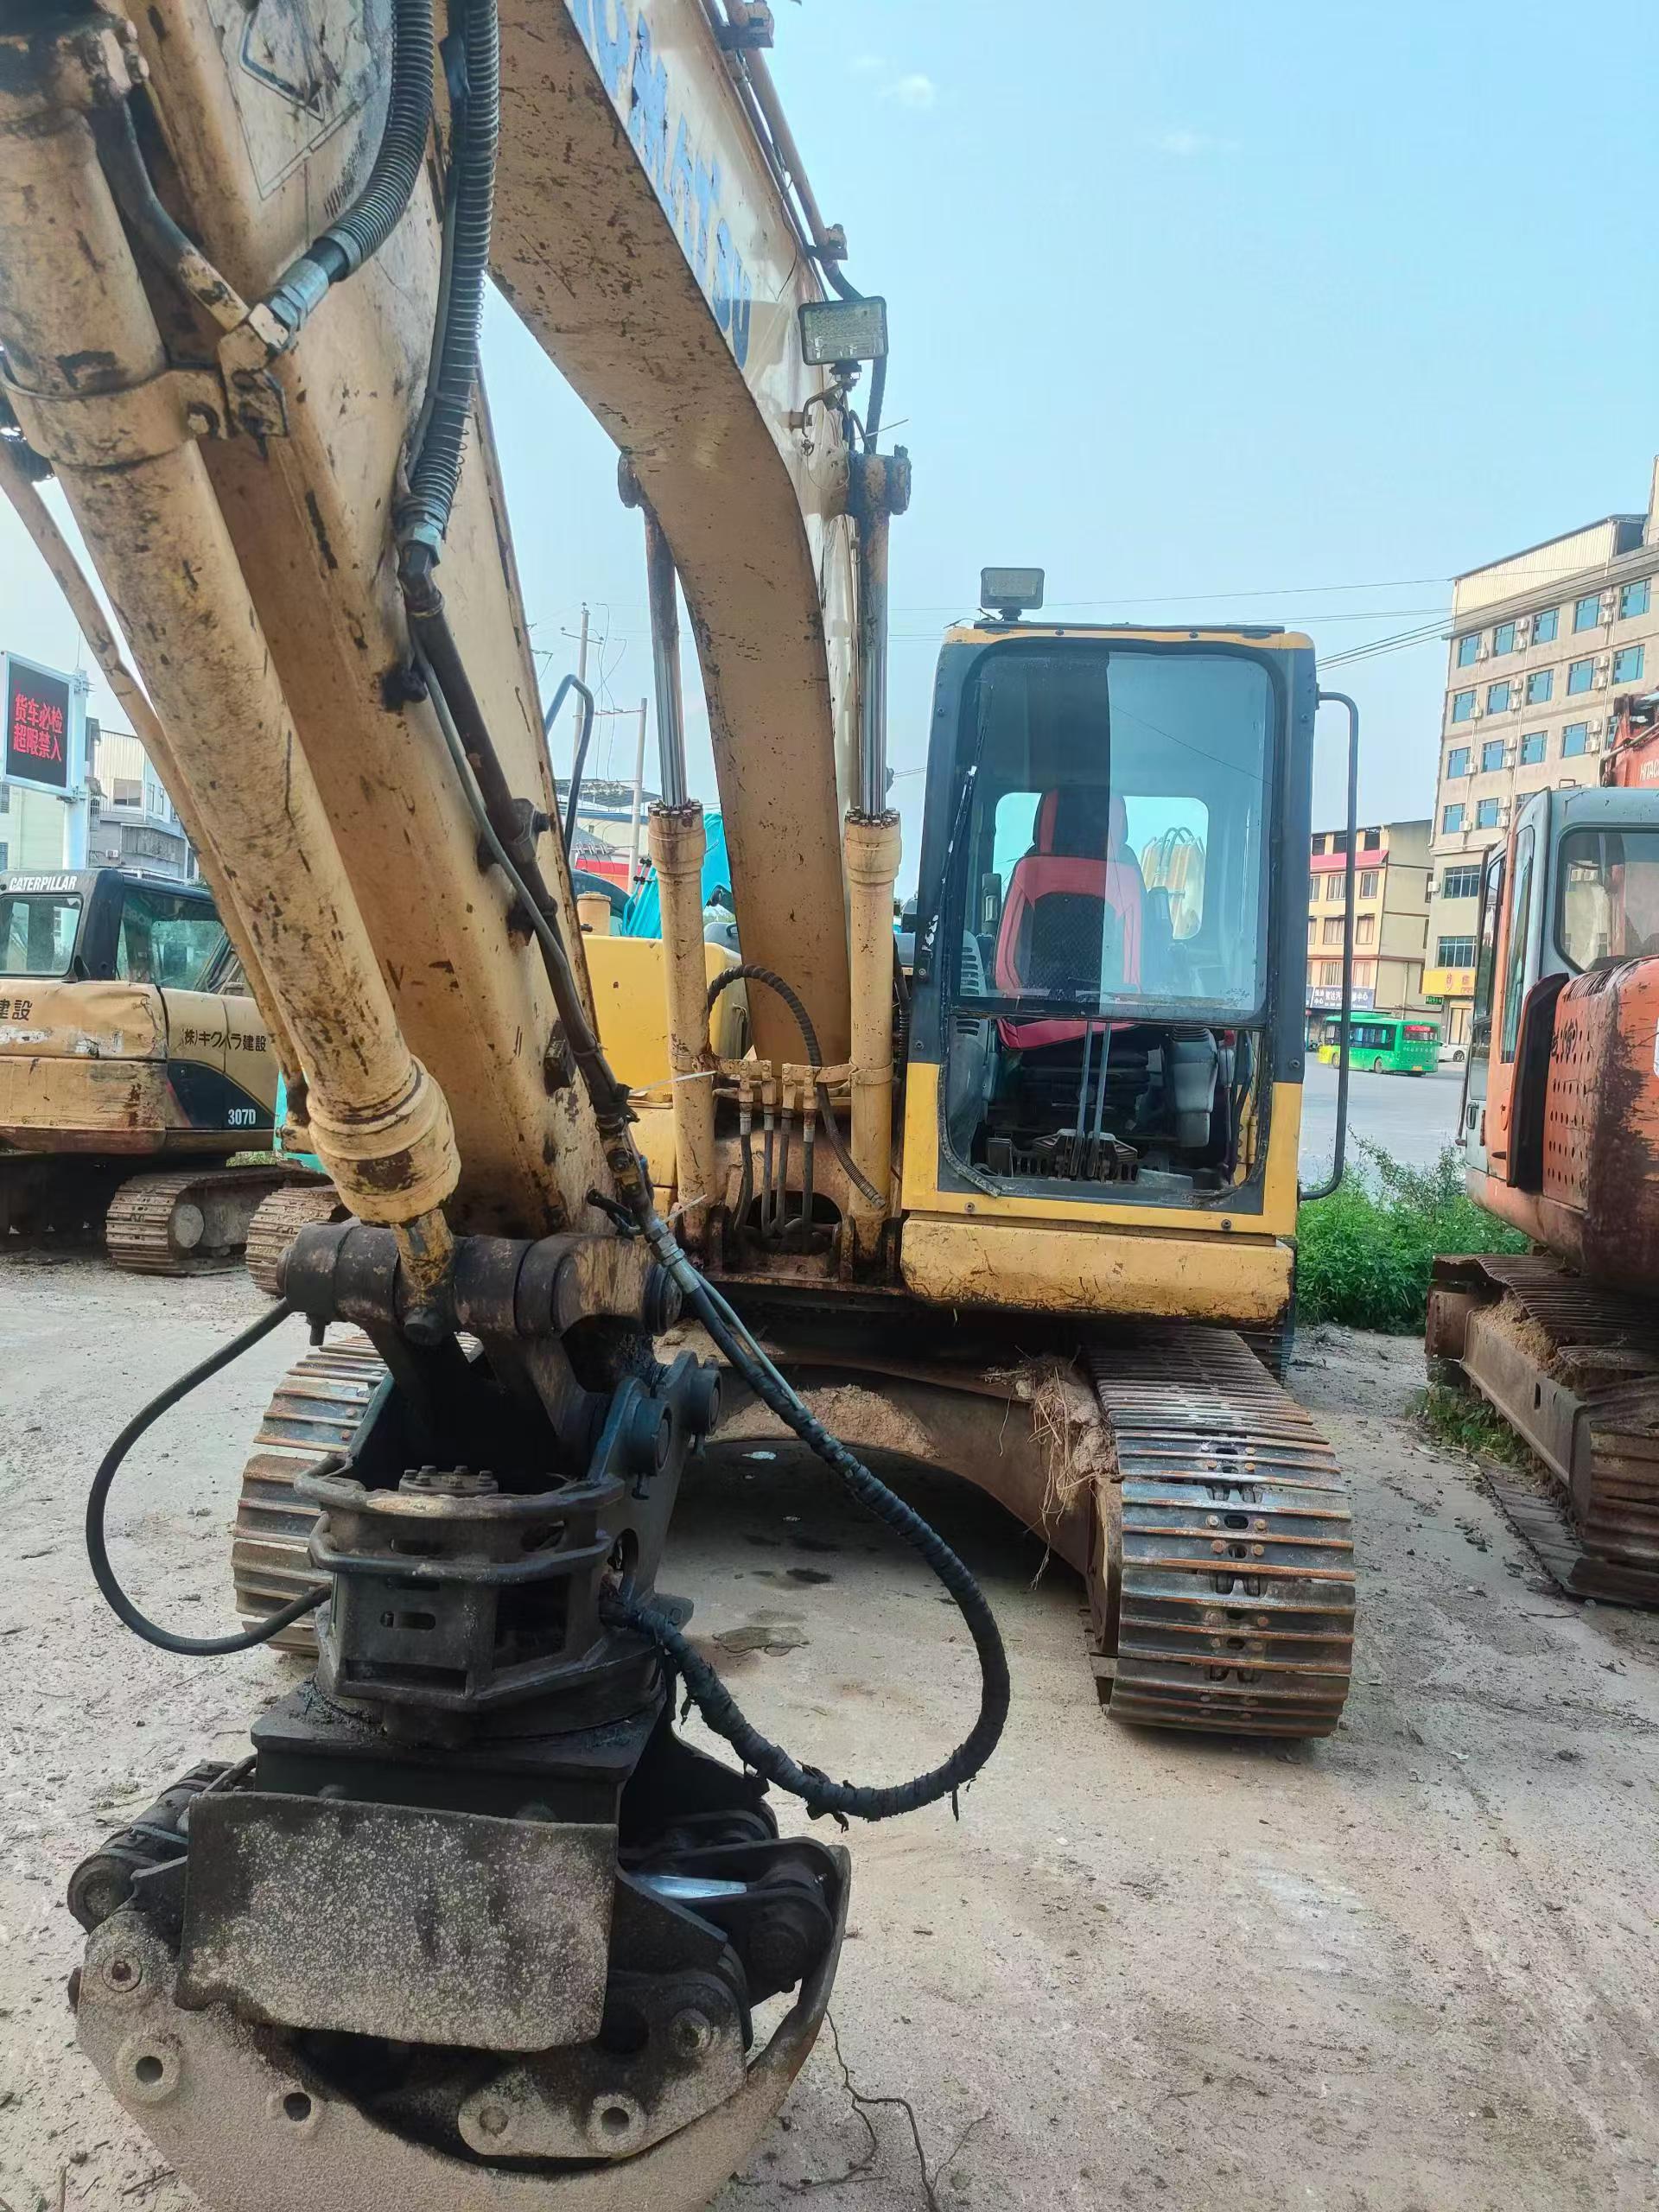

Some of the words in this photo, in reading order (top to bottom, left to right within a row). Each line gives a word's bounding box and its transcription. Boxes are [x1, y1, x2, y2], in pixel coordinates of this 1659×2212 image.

[15, 693, 63, 734] 货车必检
[13, 722, 62, 762] 超限禁入
[9, 875, 78, 892] CATERPILLAR
[227, 1108, 257, 1126] 307D
